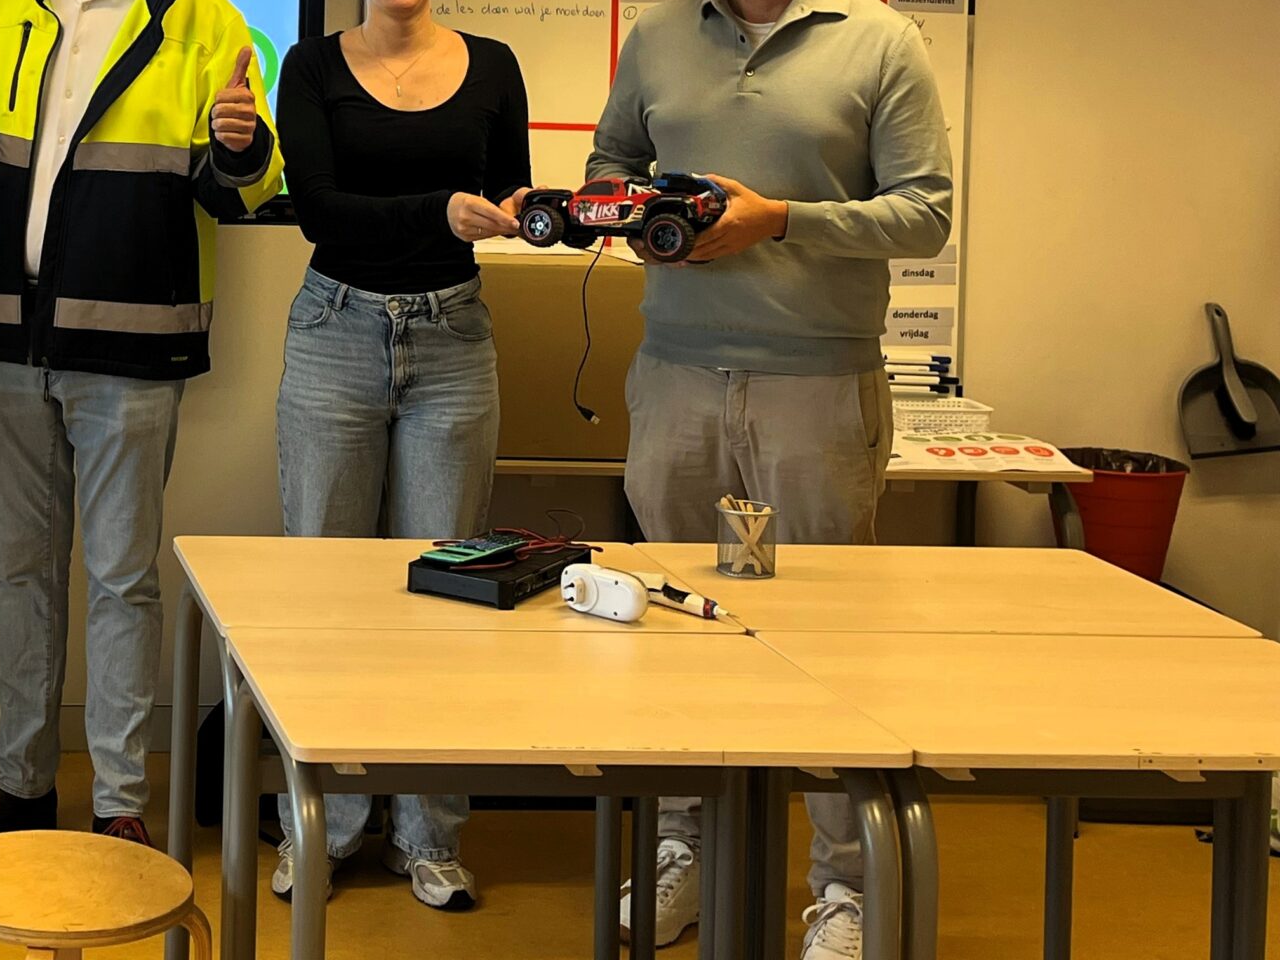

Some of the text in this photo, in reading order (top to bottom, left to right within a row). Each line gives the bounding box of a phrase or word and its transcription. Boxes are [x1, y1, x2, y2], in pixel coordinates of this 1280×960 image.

[514, 3, 535, 16] wat
[540, 7, 552, 22] je
[556, 5, 581, 18] moet
[902, 269, 935, 278] dinsdag
[893, 310, 938, 320] donderdag
[900, 329, 929, 339] vrijdag
